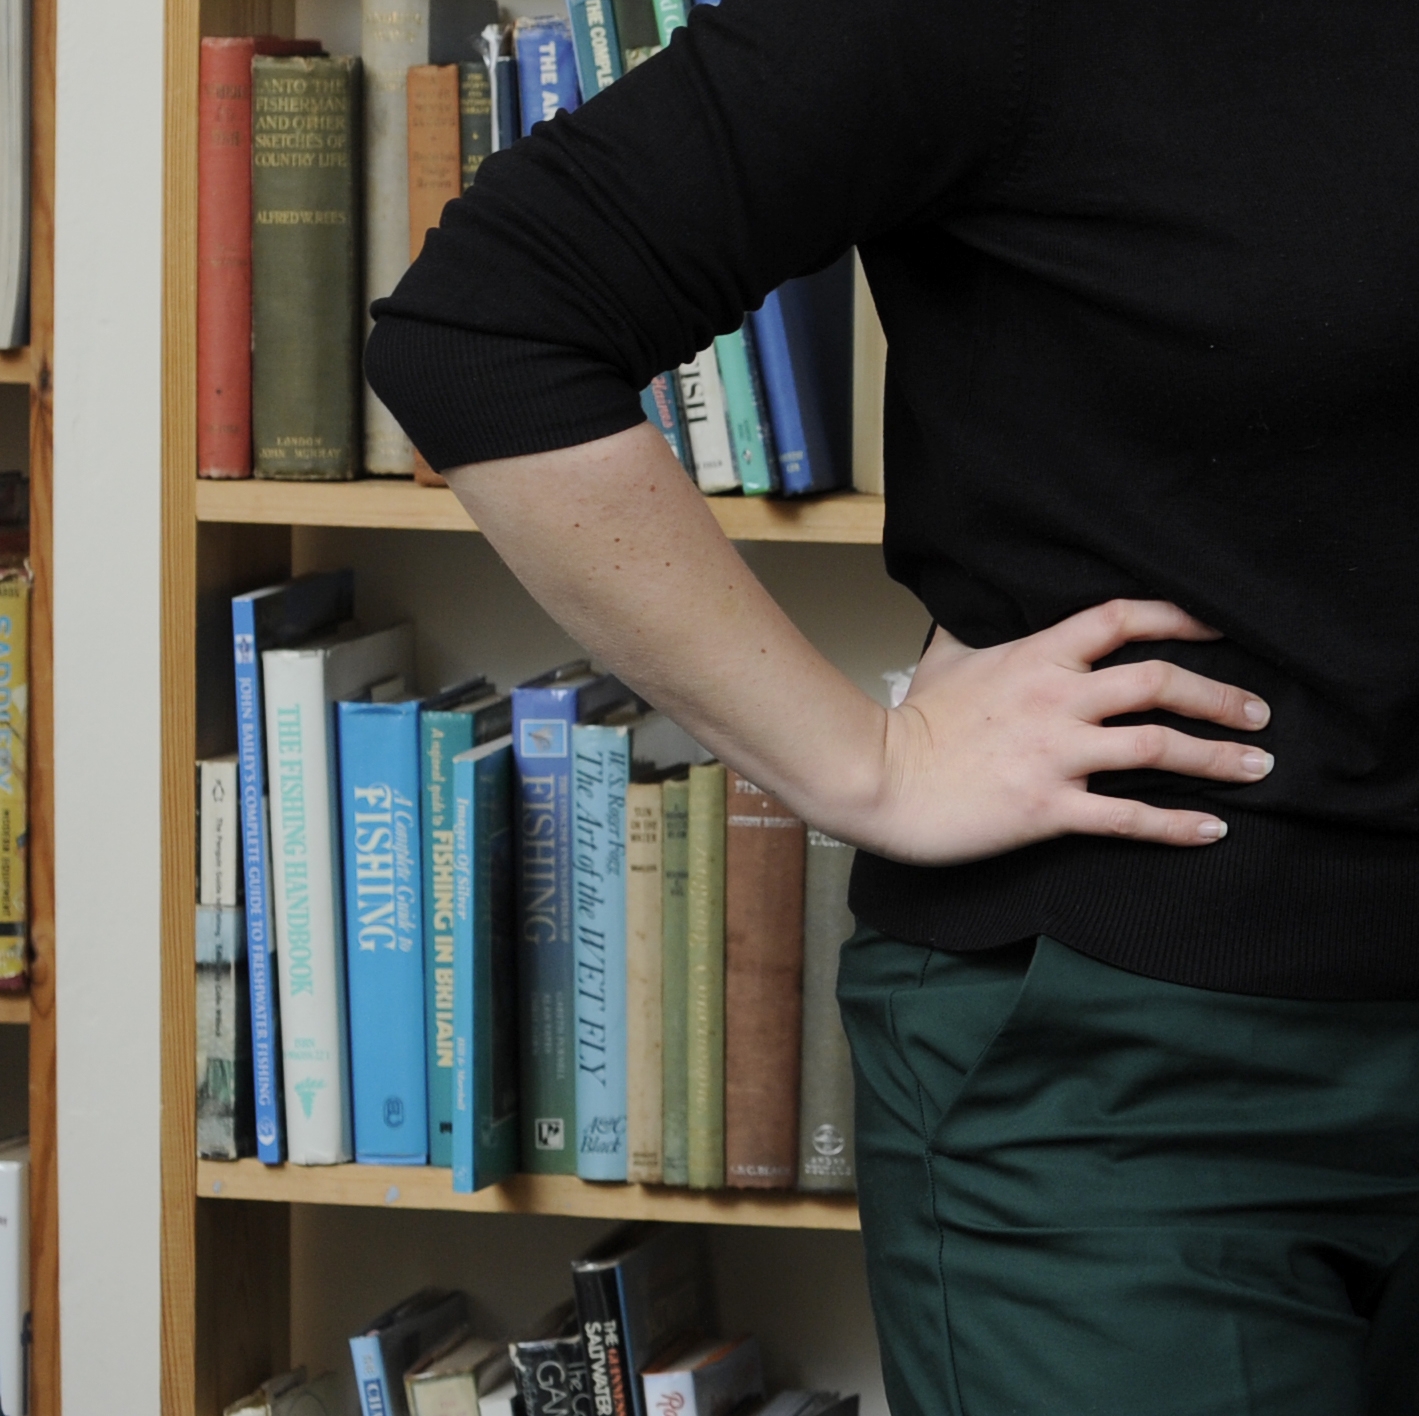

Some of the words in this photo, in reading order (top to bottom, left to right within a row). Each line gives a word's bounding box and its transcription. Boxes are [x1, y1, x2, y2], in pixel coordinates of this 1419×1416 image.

[255, 96, 347, 112] FISHERMAN
[256, 115, 289, 131] AND
[292, 115, 346, 132] OTHER
[254, 152, 316, 168] COUNTRY
[318, 152, 347, 167] LIFE
[255, 133, 324, 150] SKETCHES
[326, 134, 346, 149] OF
[276, 436, 322, 447] LONDON
[237, 676, 254, 719] JOHN
[240, 722, 256, 783] BAILEY'S
[276, 703, 302, 754] THE
[392, 788, 412, 807] A
[573, 749, 604, 798] The
[243, 785, 260, 864] COMPLETE
[278, 759, 306, 856] FISHING
[453, 797, 469, 852] Images
[574, 801, 604, 850] Art
[352, 783, 401, 953] FISHING
[390, 809, 415, 880] Complete
[455, 854, 468, 872] Of
[521, 771, 557, 945] FISHING
[573, 852, 603, 880] of
[247, 866, 263, 916] GUIDE
[394, 884, 418, 932] Guide
[455, 876, 468, 920] Silver
[576, 880, 603, 920] the
[249, 918, 264, 941] TO
[284, 860, 314, 997] HANDBOOK
[398, 935, 415, 952] to
[577, 918, 608, 1012] WET
[250, 944, 268, 1039] FRESHWATER
[254, 1041, 271, 1106] FISHING
[577, 1015, 608, 1088] FLY
[604, 1319, 619, 1348] THE
